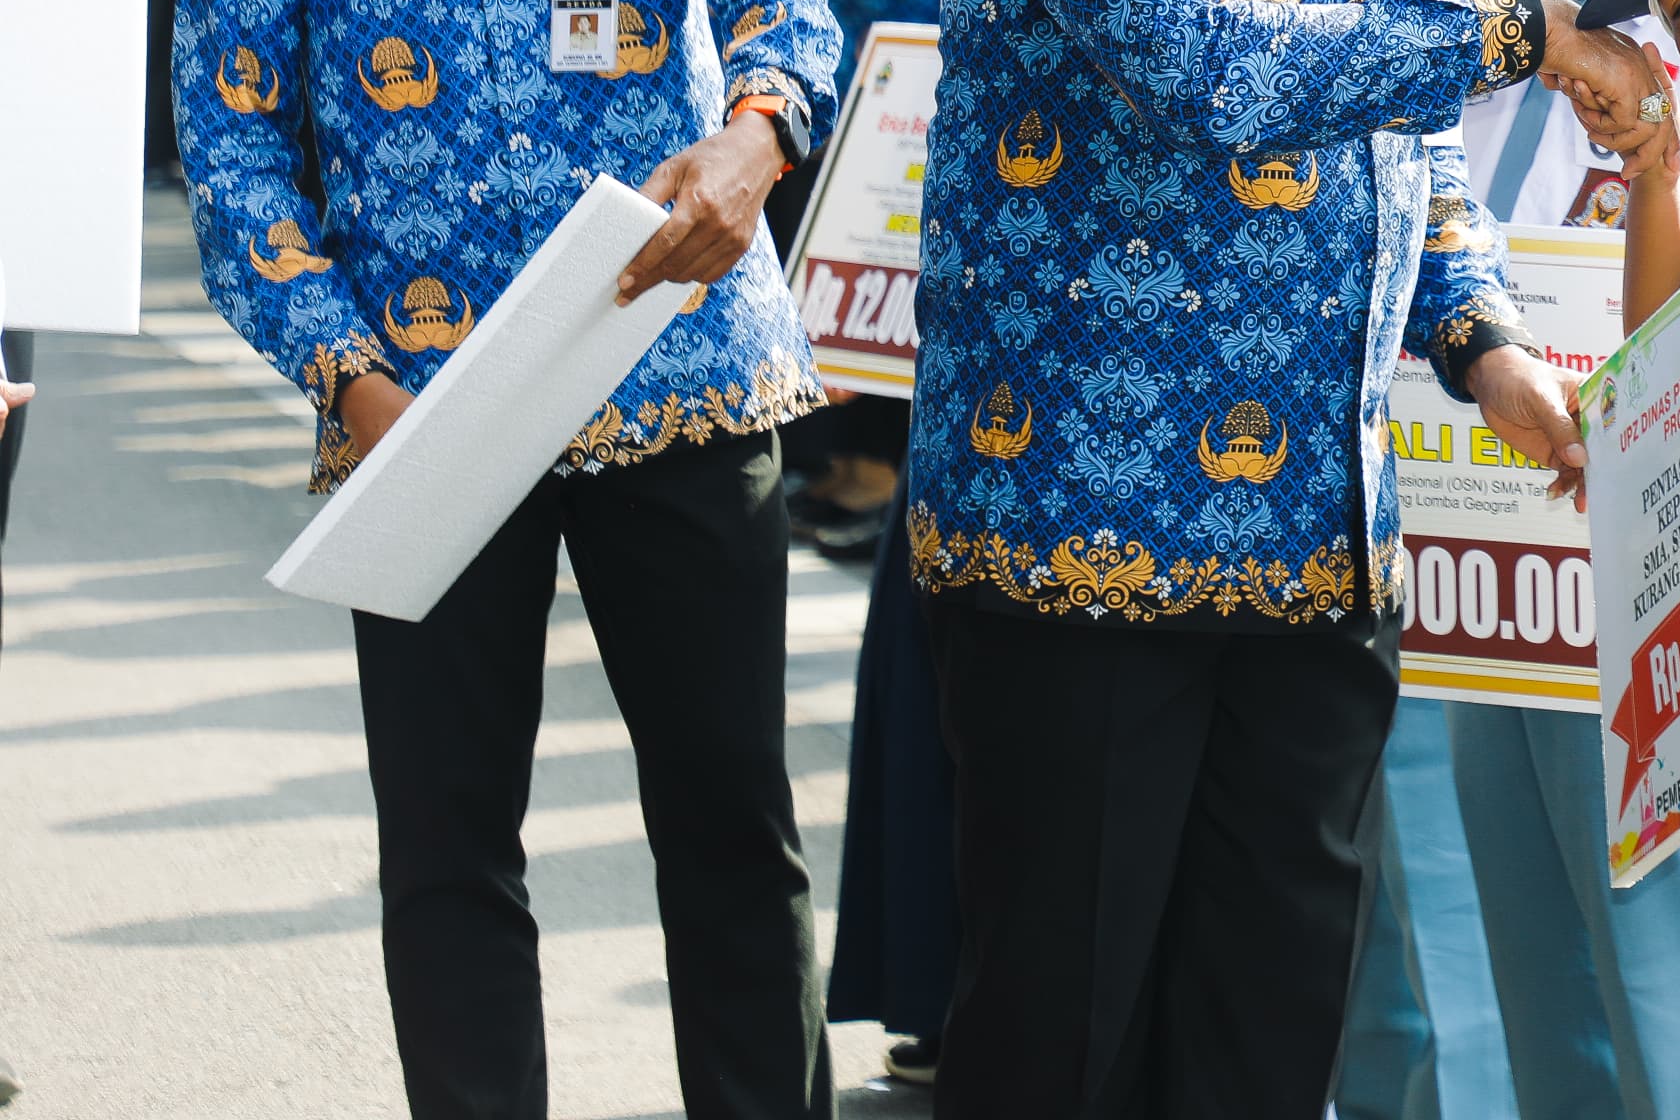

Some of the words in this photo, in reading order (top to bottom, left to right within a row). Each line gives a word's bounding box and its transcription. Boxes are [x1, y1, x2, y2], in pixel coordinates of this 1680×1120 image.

[1620, 419, 1639, 453] UPZ
[1641, 391, 1671, 434] DINAS
[1416, 493, 1459, 508] Lomba
[1464, 497, 1520, 515] Geografi
[1446, 477, 1488, 493] (OSN)
[1491, 483, 1522, 496] SMA
[1643, 542, 1671, 579] SMA,
[1633, 563, 1680, 622] KURANG
